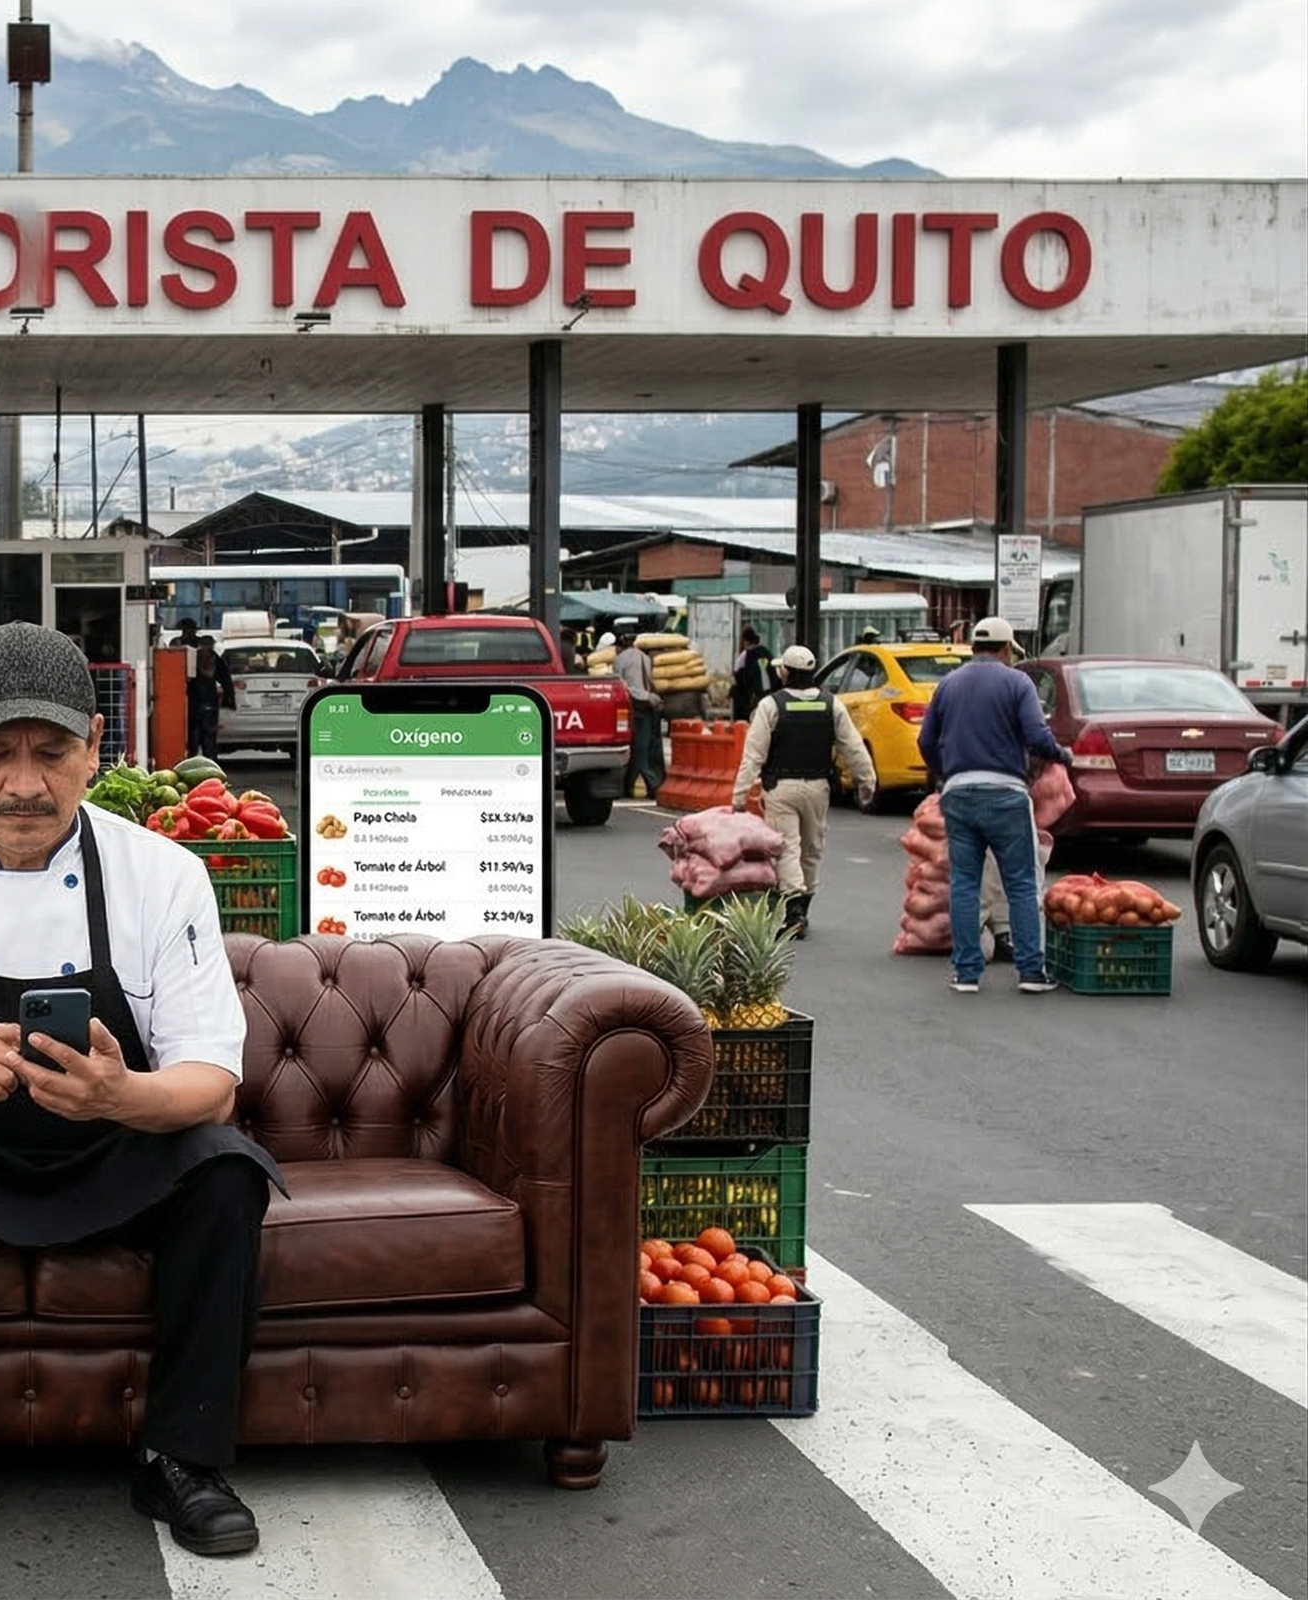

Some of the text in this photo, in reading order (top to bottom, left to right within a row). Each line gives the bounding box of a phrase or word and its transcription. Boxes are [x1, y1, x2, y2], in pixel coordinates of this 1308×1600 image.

[470, 211, 636, 306] DE
[698, 212, 1092, 312] QUITO
[389, 727, 463, 748] Oxígeno
[353, 811, 382, 825] Papa
[383, 811, 417, 823] Chola
[353, 860, 396, 873] Tomate
[398, 860, 413, 873] de
[414, 858, 446, 873] Árbol
[353, 910, 396, 922] Tomate
[398, 909, 413, 922] de
[414, 907, 446, 922] Árbol
